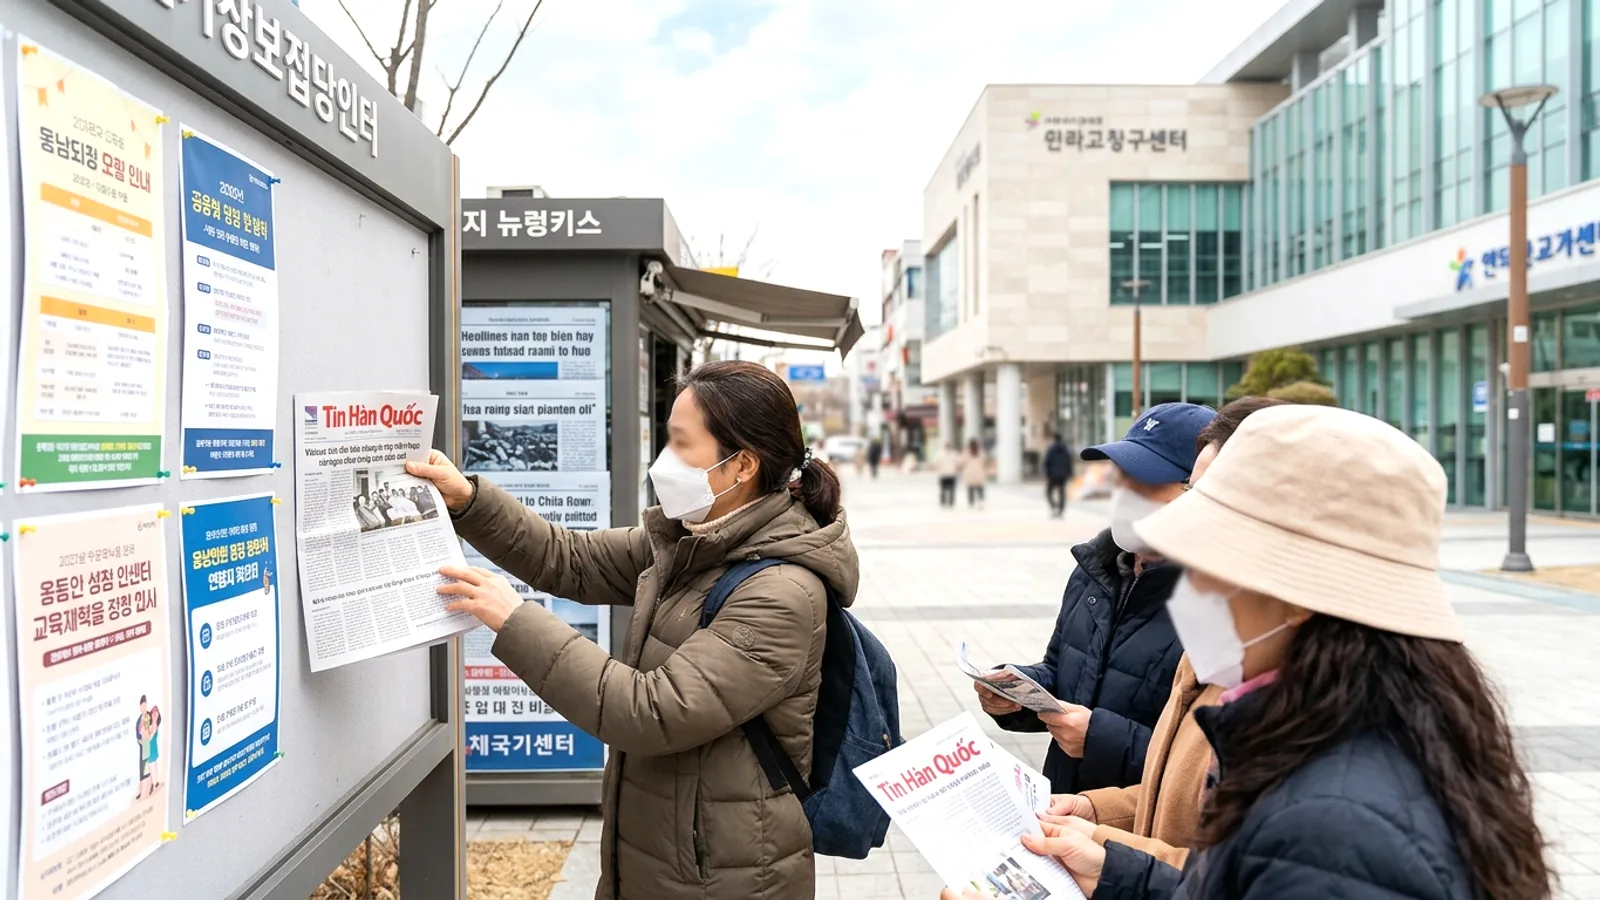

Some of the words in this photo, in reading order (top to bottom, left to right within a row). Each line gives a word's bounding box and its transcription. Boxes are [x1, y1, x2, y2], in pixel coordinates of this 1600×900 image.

[558, 346, 569, 357] to
[322, 405, 346, 428] Tin
[348, 404, 377, 427] Hàn
[380, 402, 423, 428] Quốc
[876, 780, 909, 802] Tin
[900, 767, 938, 792] Hàn
[932, 737, 981, 775] Quốc
